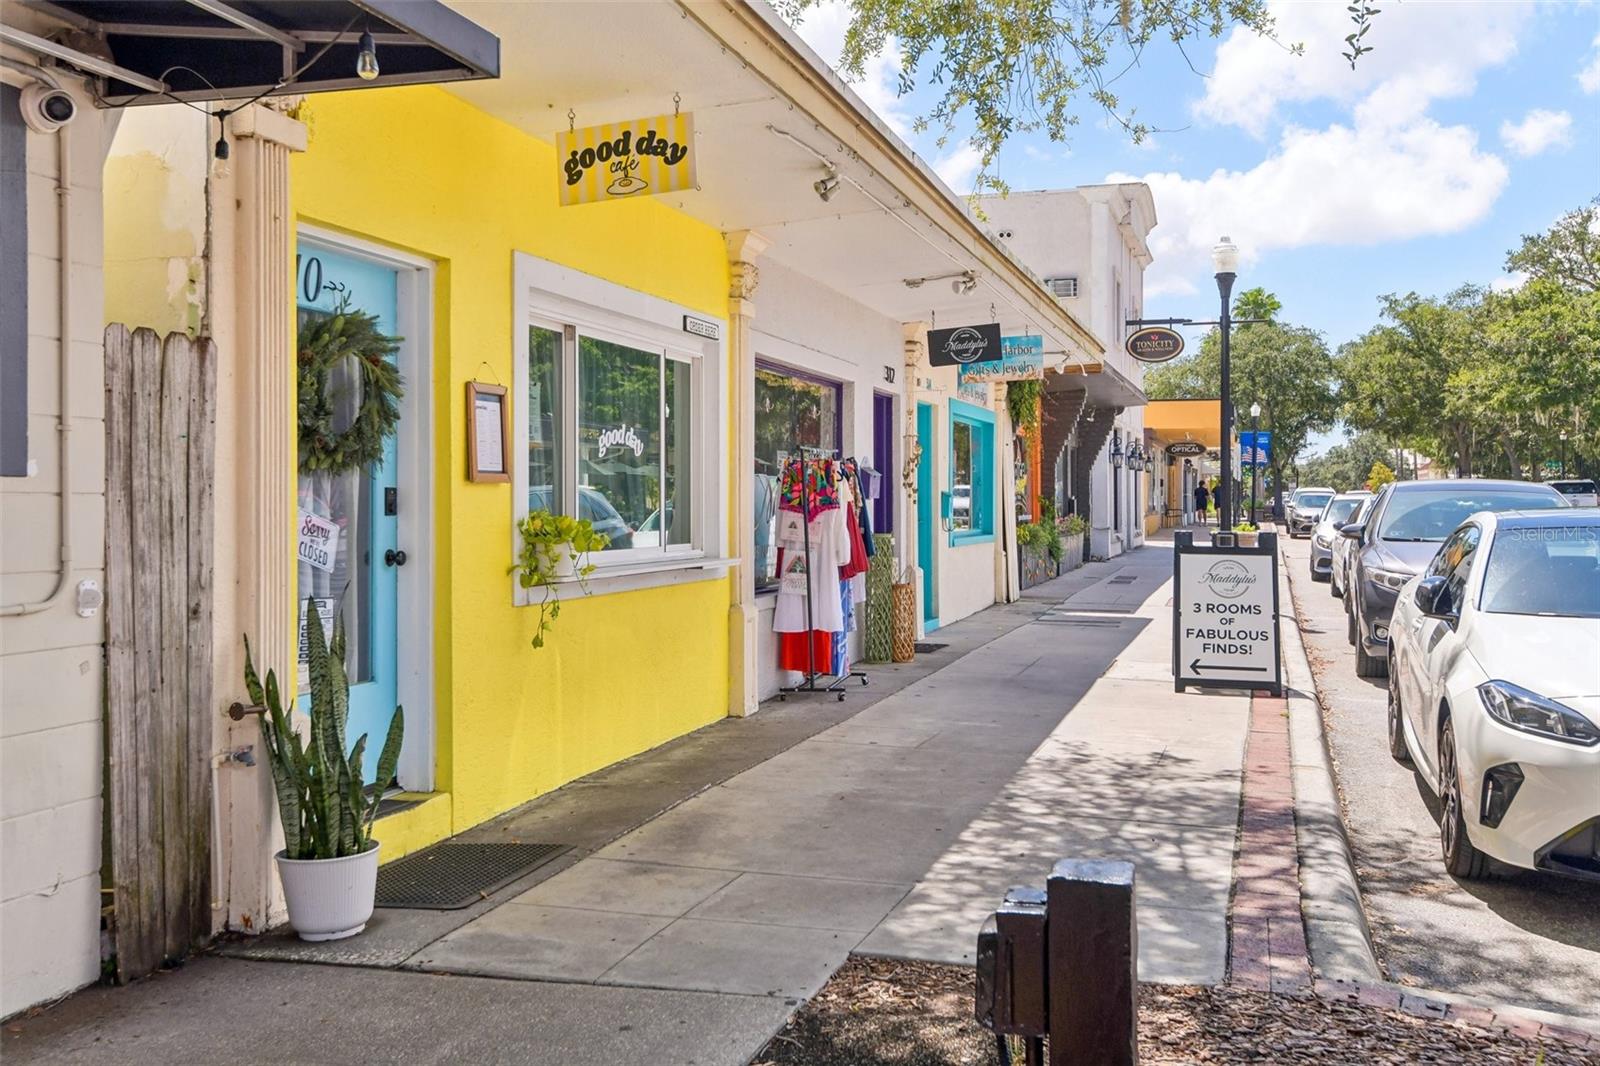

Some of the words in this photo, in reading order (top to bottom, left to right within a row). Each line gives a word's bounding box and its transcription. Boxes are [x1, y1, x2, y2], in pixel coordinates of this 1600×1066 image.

[564, 130, 631, 186] good
[635, 130, 688, 166] day
[610, 153, 640, 178] café
[1135, 339, 1175, 349] TONICITY
[598, 424, 626, 458] good
[625, 427, 644, 457] day
[301, 514, 330, 546] Sorry
[298, 540, 329, 566] CLOSED
[1198, 573, 1257, 589] Maddylu's
[1193, 602, 1202, 613] 3
[1206, 603, 1262, 615] ROOMS
[1219, 617, 1235, 626] OF
[1186, 628, 1269, 641] FABULOUS
[1202, 643, 1253, 655] FINDS!
